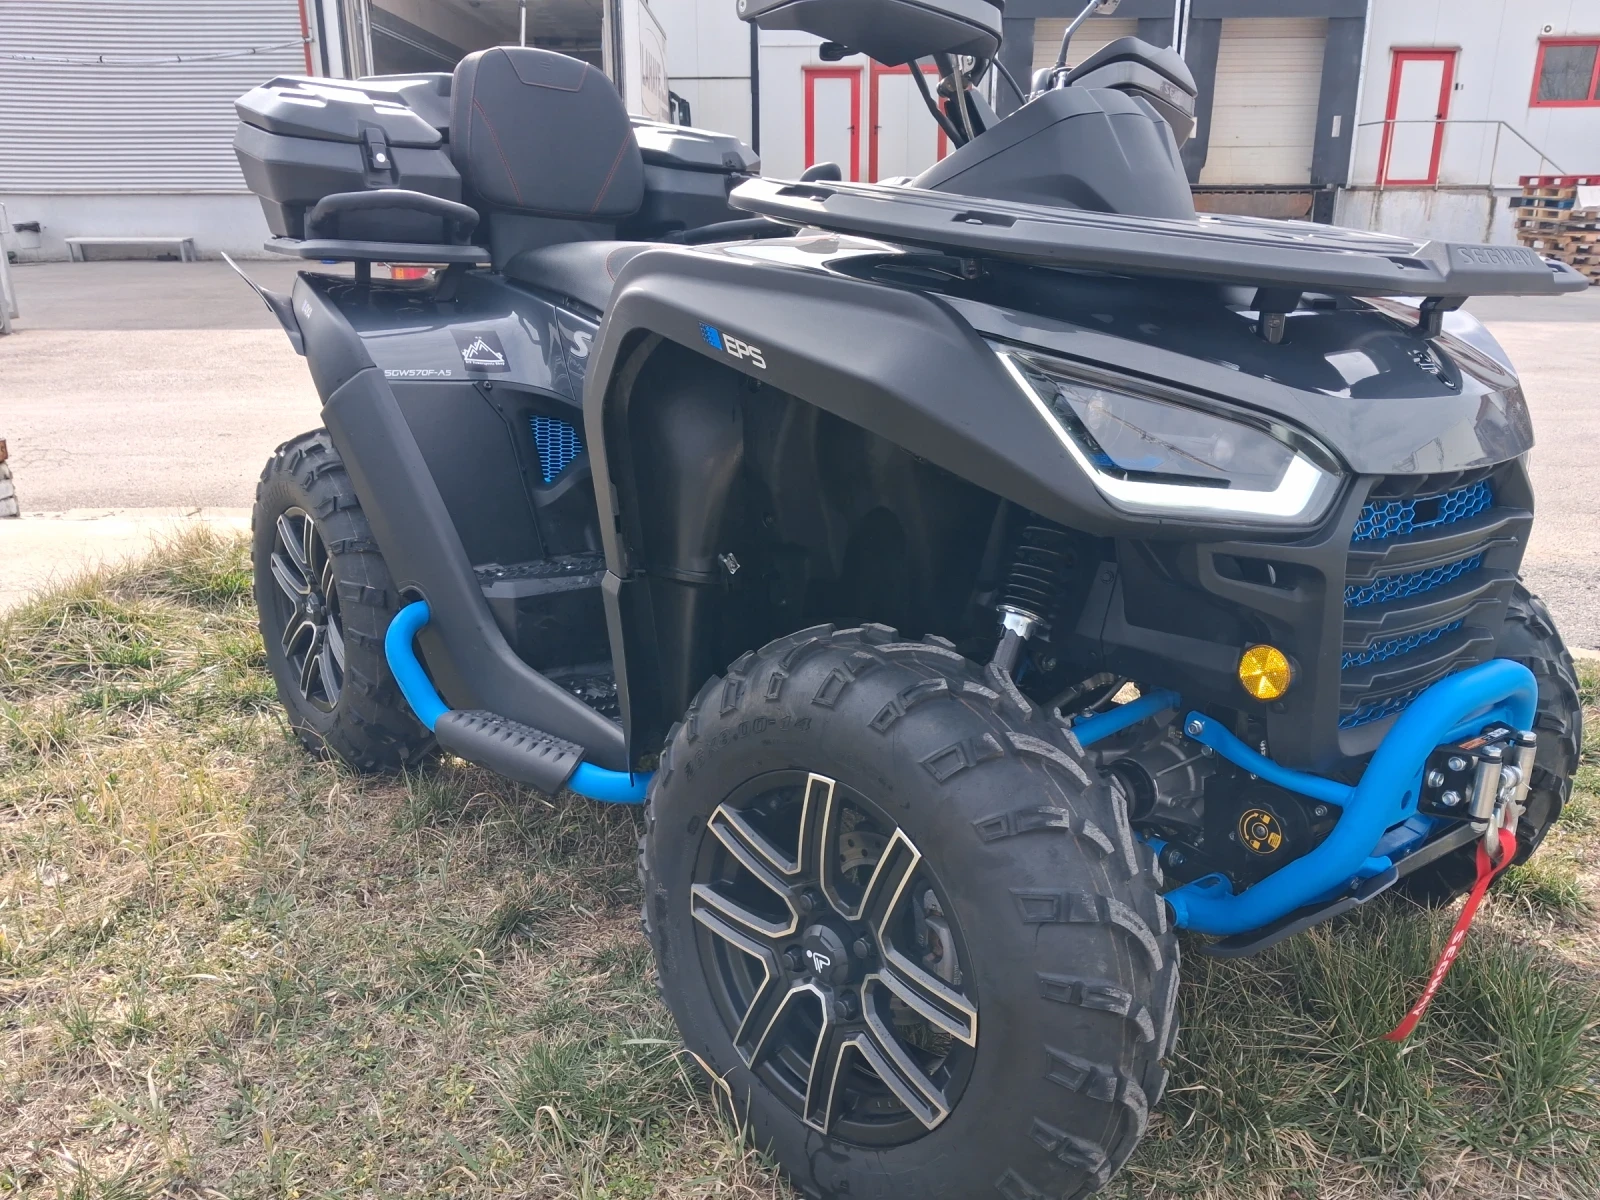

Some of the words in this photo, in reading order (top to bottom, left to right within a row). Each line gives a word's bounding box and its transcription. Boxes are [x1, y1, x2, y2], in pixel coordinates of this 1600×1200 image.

[1457, 246, 1535, 268] SEGWAY
[722, 333, 767, 370] EPS
[1412, 929, 1464, 1016] SEGWAY
